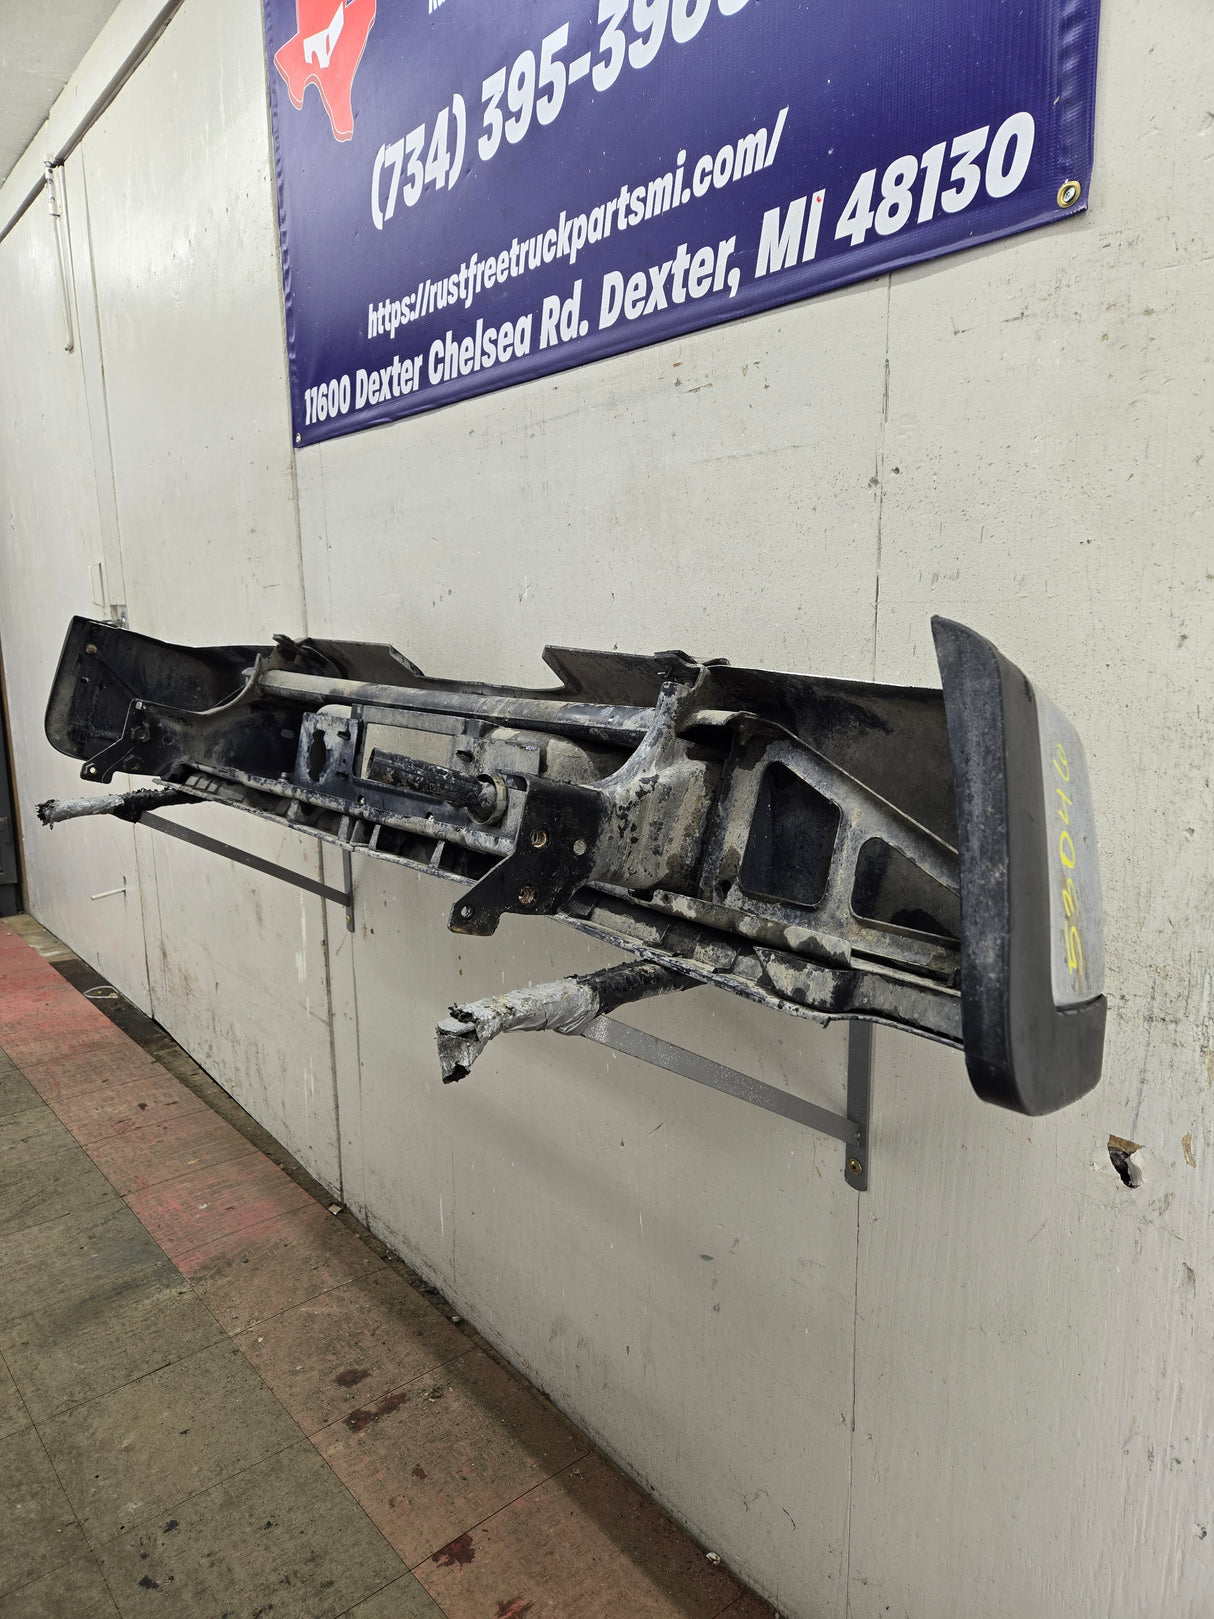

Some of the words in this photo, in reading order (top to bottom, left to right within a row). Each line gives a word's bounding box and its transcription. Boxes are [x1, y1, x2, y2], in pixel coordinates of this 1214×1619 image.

[367, 105, 789, 340] https://rustfreetruckpartsmi.com/
[371, 92, 467, 230] (734)
[478, 0, 749, 161] 395-39
[304, 375, 351, 425] 11600
[355, 354, 423, 409] Dexter
[428, 313, 532, 385] Chelsea
[539, 279, 590, 349] Rd.
[598, 235, 740, 330] Dexter,
[755, 188, 826, 278] MI
[834, 112, 1036, 246] 48130
